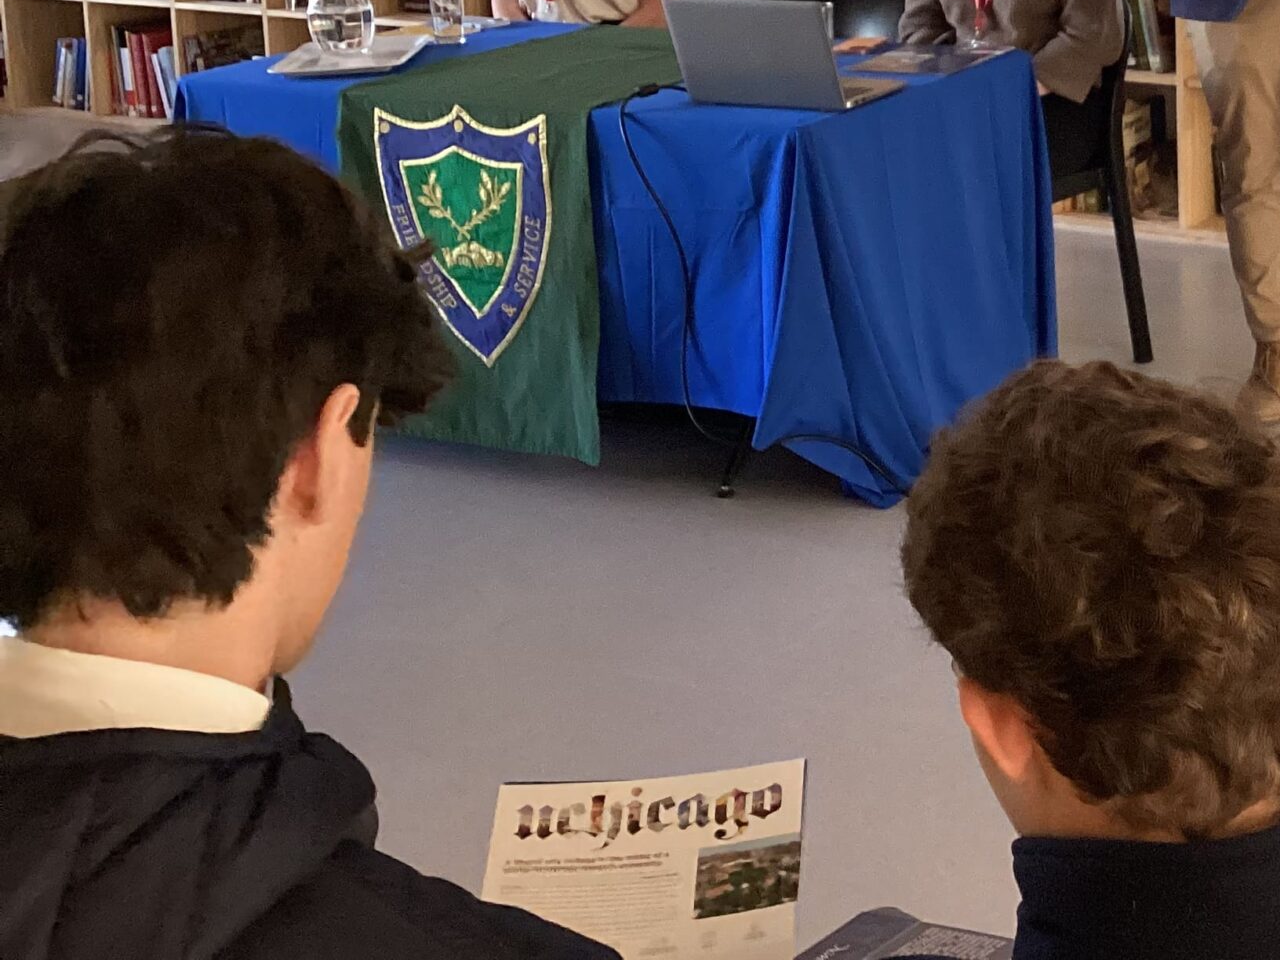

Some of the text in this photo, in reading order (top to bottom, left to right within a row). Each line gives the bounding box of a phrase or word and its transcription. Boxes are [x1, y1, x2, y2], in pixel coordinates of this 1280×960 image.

[392, 204, 458, 309] FRIEDSHIP
[513, 214, 542, 299] SERVICE
[513, 781, 784, 852] uchicago
